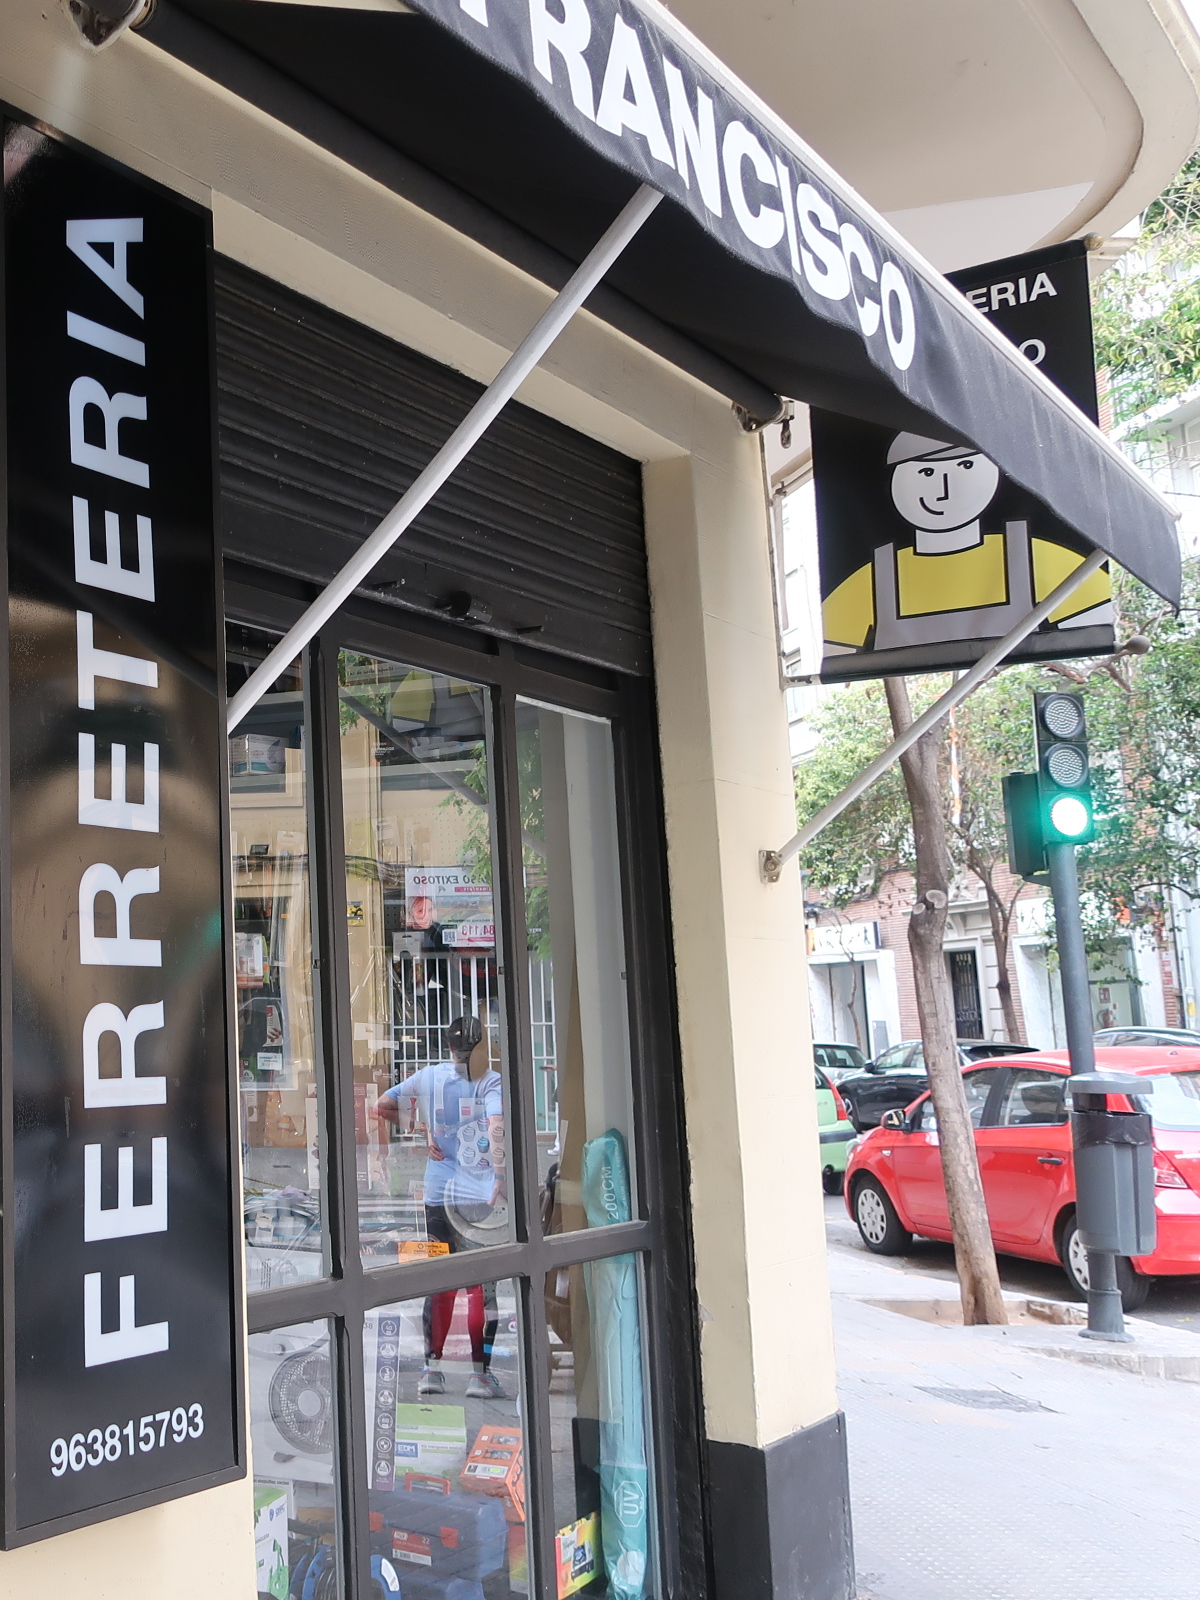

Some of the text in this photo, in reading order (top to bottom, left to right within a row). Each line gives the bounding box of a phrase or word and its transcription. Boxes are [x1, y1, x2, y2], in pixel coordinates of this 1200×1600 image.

[459, 0, 915, 370] RANCISCO
[66, 217, 169, 1368] FERRETERIA
[50, 1402, 204, 1477] 963815793
